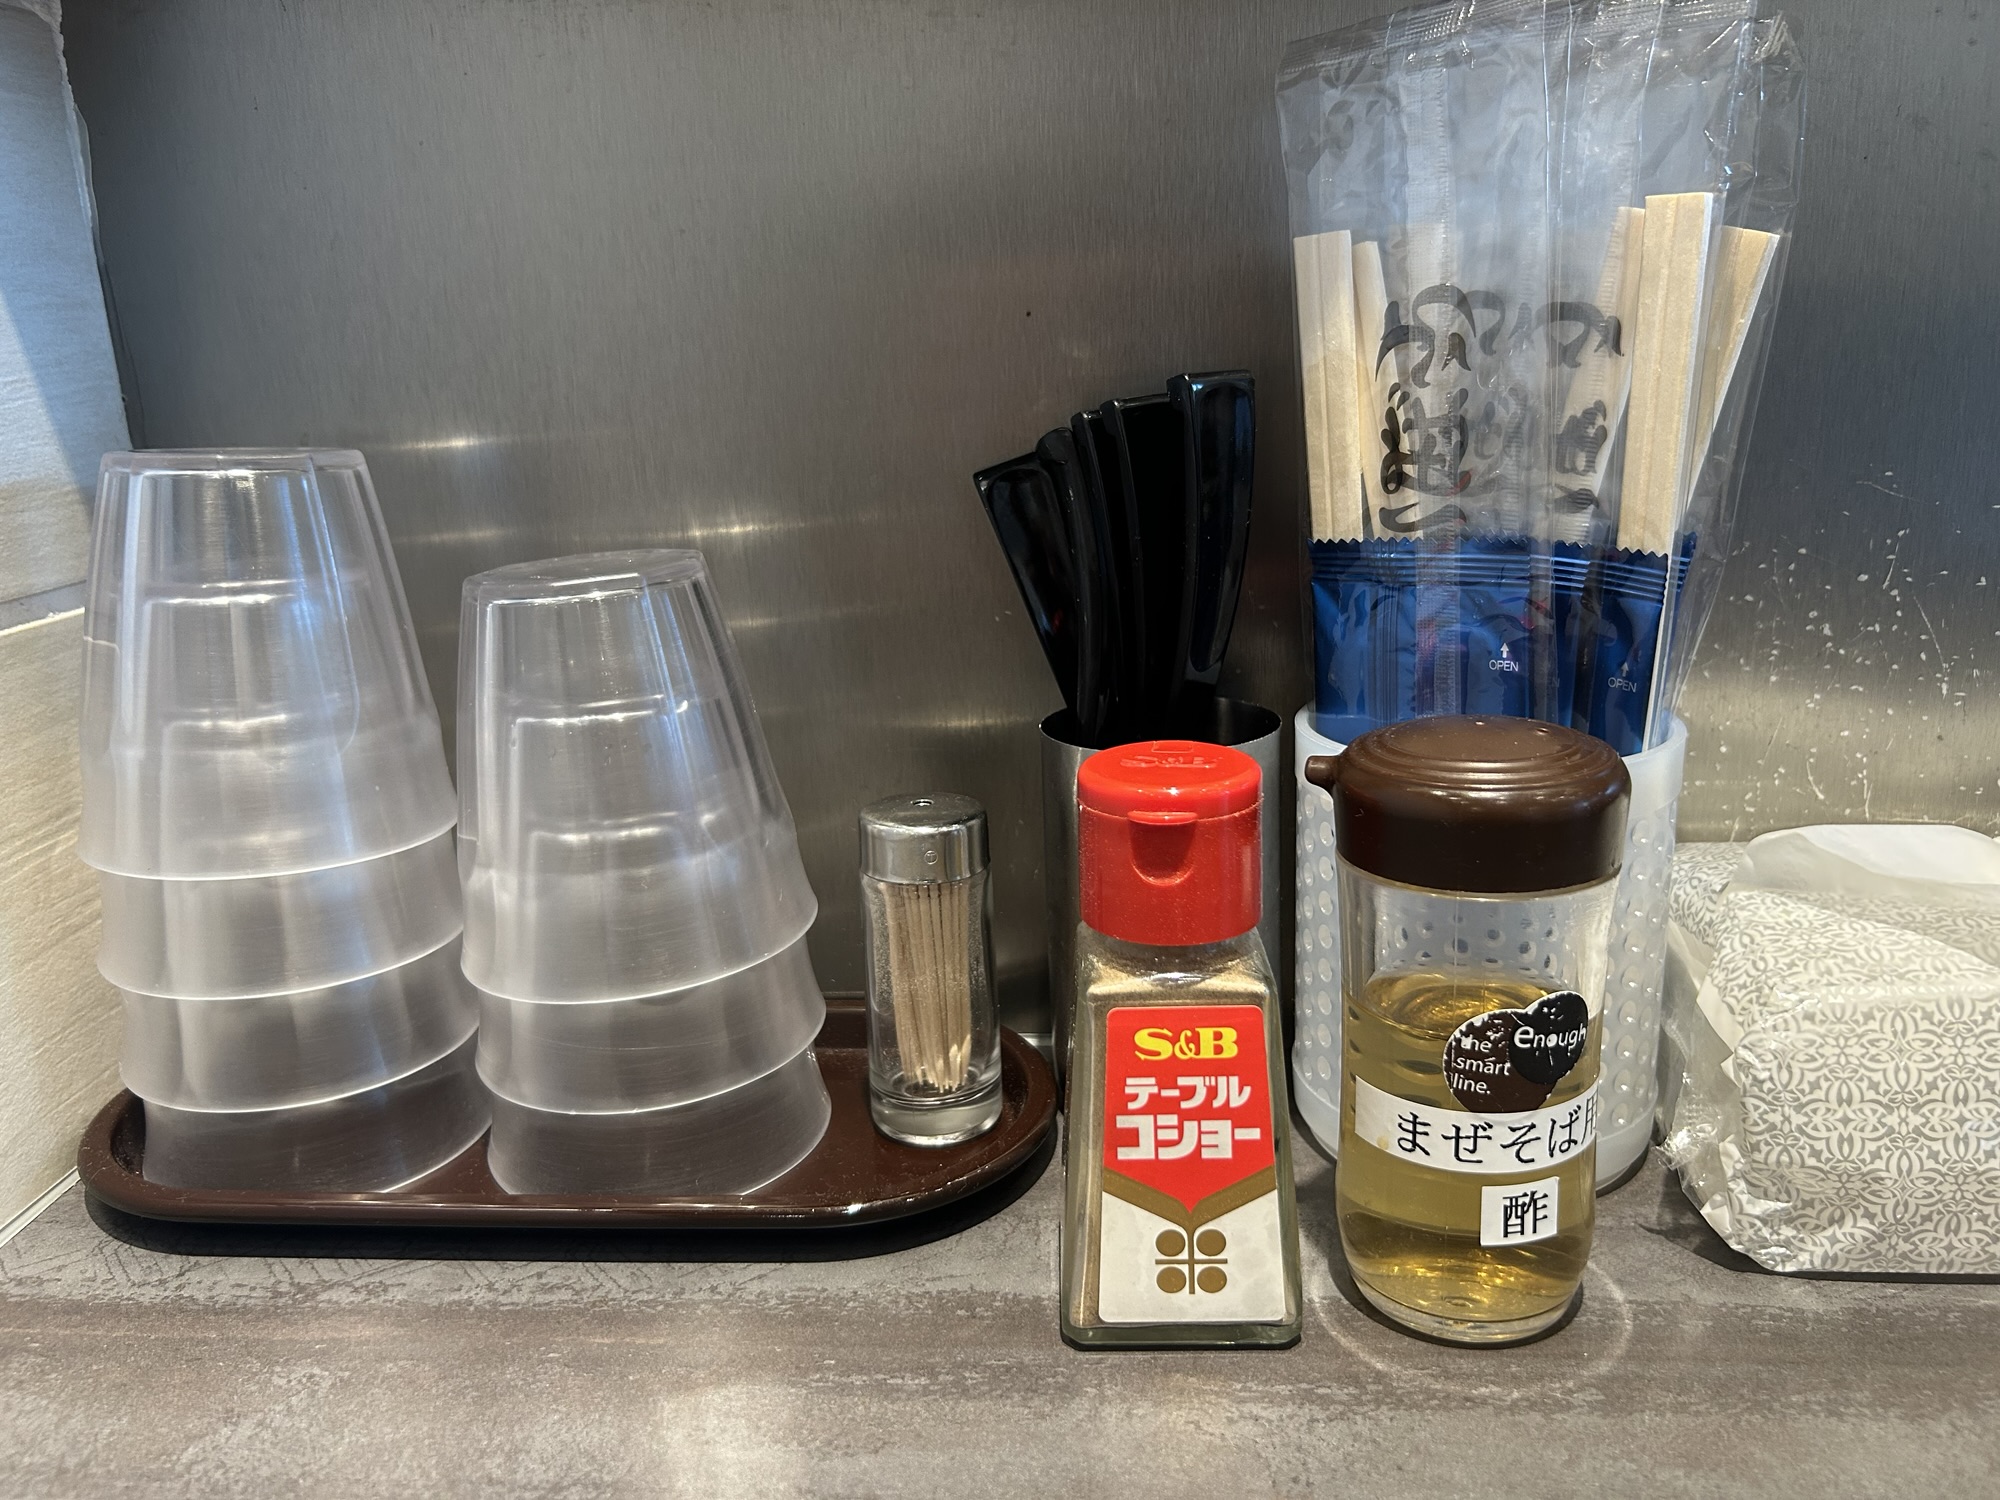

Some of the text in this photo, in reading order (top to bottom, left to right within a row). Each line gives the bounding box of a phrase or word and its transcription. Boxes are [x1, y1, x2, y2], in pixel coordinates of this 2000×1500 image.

[1488, 659, 1519, 672] OPEN
[1607, 677, 1637, 693] OPEN
[1133, 1026, 1239, 1061] S&B
[1455, 1056, 1511, 1076] smart
[1124, 1075, 1252, 1110] テーブル
[1453, 1073, 1491, 1095] line.
[1115, 1113, 1261, 1161] コショー
[1502, 1189, 1550, 1239] 酢
